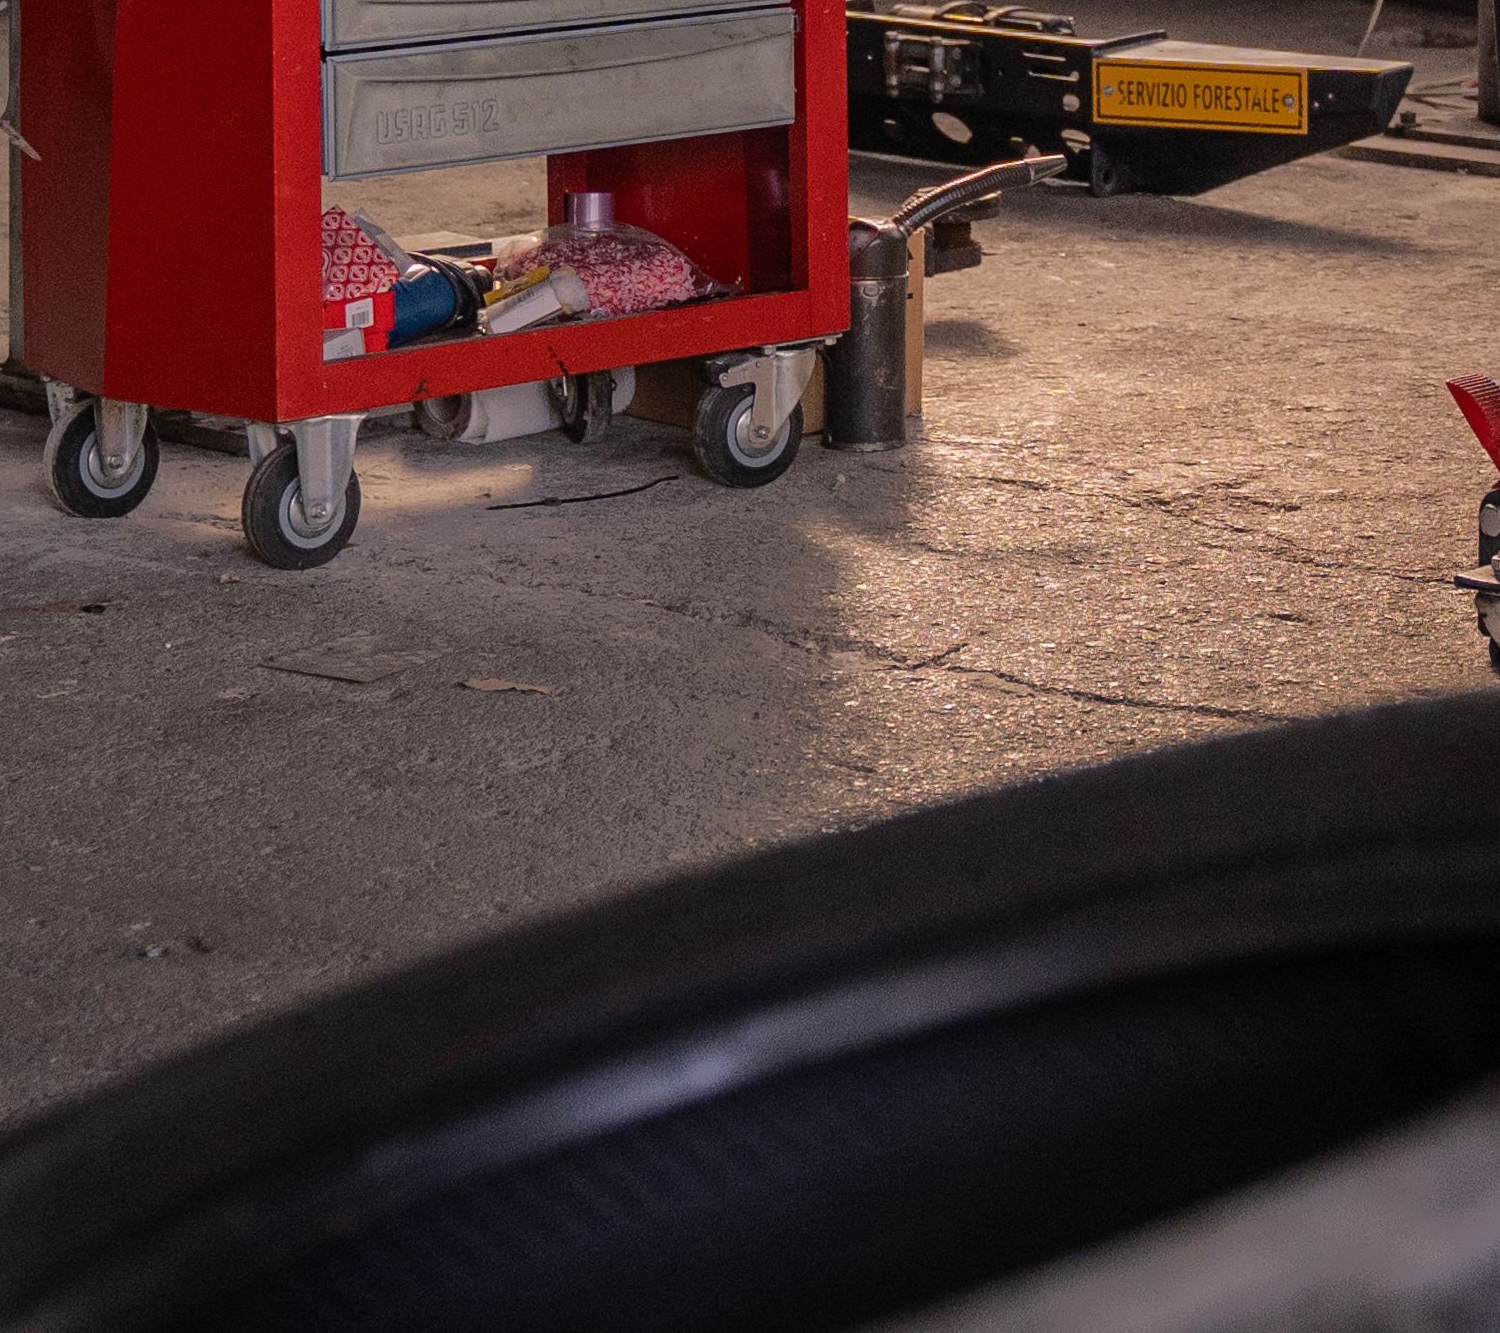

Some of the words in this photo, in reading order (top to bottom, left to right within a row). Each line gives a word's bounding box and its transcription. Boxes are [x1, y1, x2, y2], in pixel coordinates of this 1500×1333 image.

[1116, 79, 1188, 108] SERVIZIO
[1193, 84, 1280, 114] FORESTALE
[452, 98, 500, 136] 512
